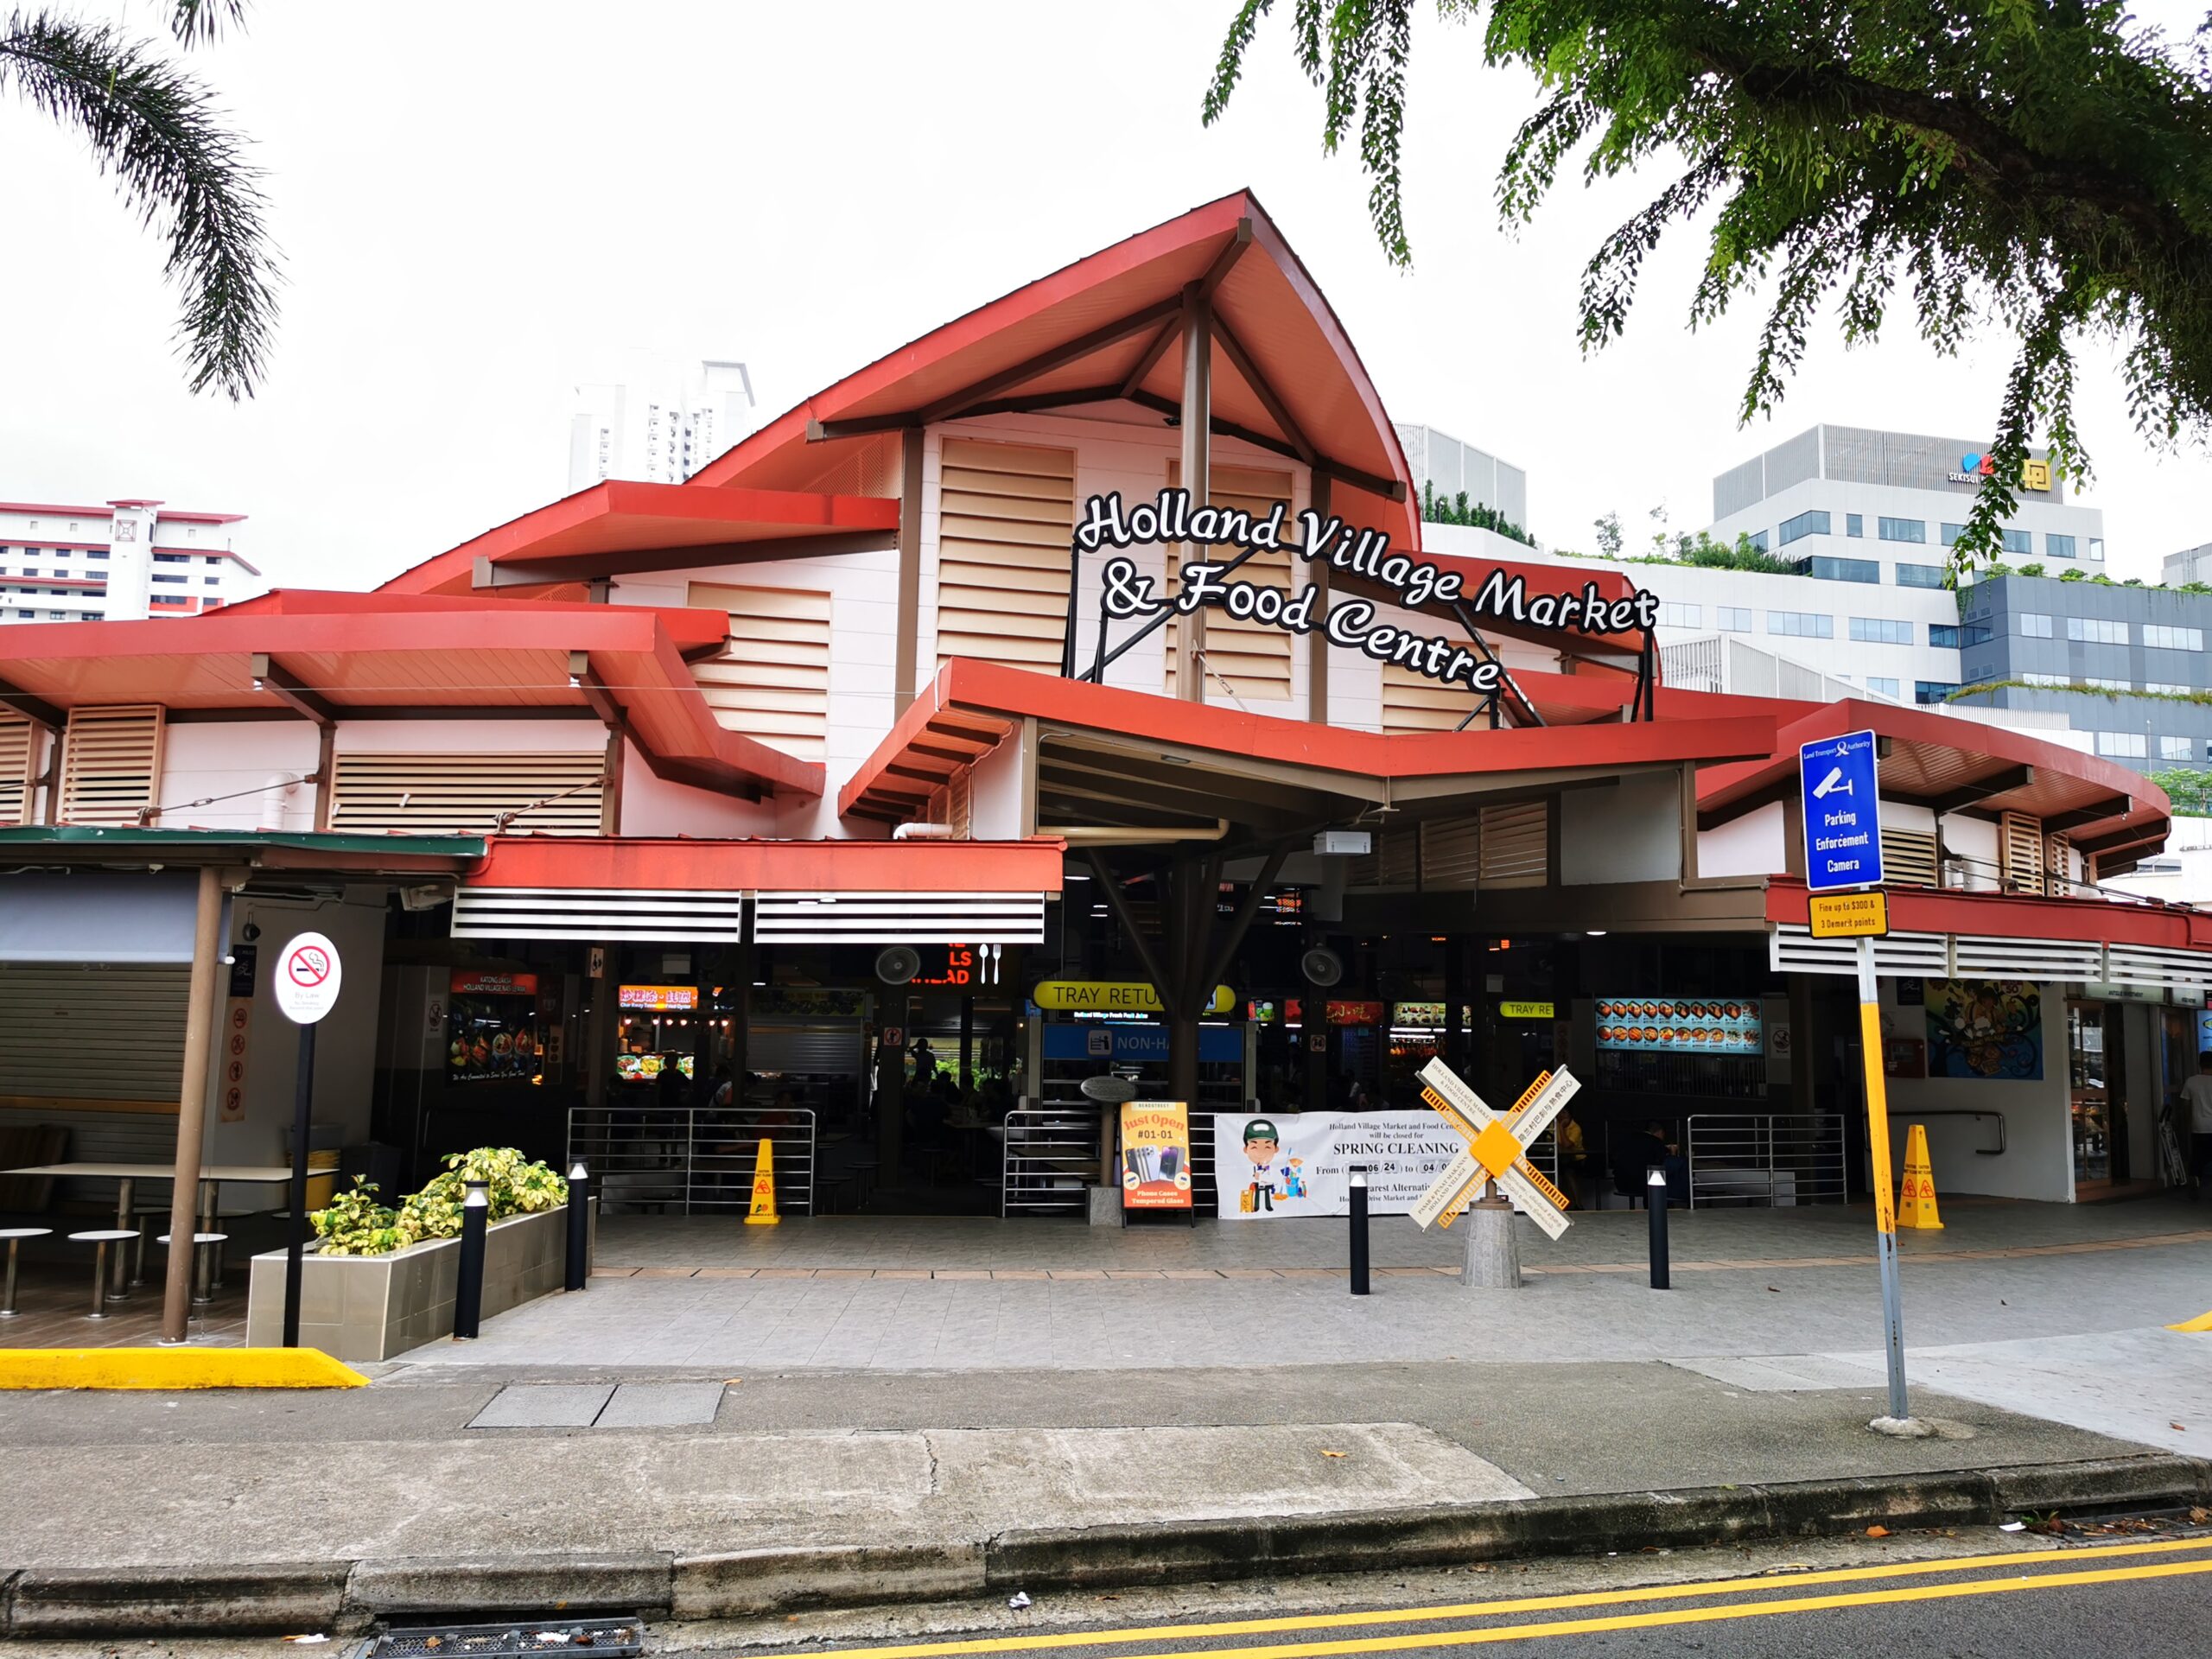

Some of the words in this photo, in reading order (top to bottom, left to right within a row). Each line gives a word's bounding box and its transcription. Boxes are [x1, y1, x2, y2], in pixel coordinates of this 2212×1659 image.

[1078, 493, 1282, 548] Holland
[1302, 512, 1463, 601] Village
[1475, 571, 1656, 631] Market
[1104, 560, 1156, 616] &
[1179, 563, 1319, 628] Food
[1326, 604, 1498, 690] Centre
[1803, 751, 1815, 760] Land
[1815, 747, 1837, 758] Transport
[1847, 740, 1871, 751] Authority
[1824, 810, 1856, 827] Parking
[1815, 833, 1869, 851] Enforcement
[1827, 859, 1859, 874] Camera
[1819, 903, 1833, 912] Fine
[1834, 903, 1842, 912] up
[1843, 901, 1850, 911] to
[1852, 900, 1868, 911] $300
[1869, 899, 1875, 908] &
[1821, 919, 1826, 929] 3
[1827, 918, 1853, 929] Demerit
[1854, 918, 1876, 928] points
[1053, 987, 1099, 1003] TRAY
[1510, 1004, 1534, 1014] TRAY
[1118, 1036, 1169, 1049] NON-H
[1432, 1064, 1453, 1086] HOLLAND
[1454, 1083, 1472, 1103] VILLAGE
[1472, 1102, 1492, 1122] MARKET
[1445, 1084, 1459, 1098] FOOD
[1458, 1096, 1477, 1115] CENTRE
[1124, 1115, 1149, 1131] Just
[1151, 1114, 1185, 1131] Open
[1329, 1122, 1357, 1131] Holland
[1357, 1122, 1381, 1131] Village
[1138, 1129, 1173, 1139] #01-01
[1333, 1142, 1383, 1155] SPRING
[1388, 1141, 1459, 1154] CLEANING
[1316, 1166, 1339, 1175] From
[1368, 1183, 1389, 1192] earest
[1428, 1187, 1449, 1211] HOLLAND
[1448, 1167, 1466, 1187] VILLAGE
[1418, 1198, 1433, 1214] PASAR
